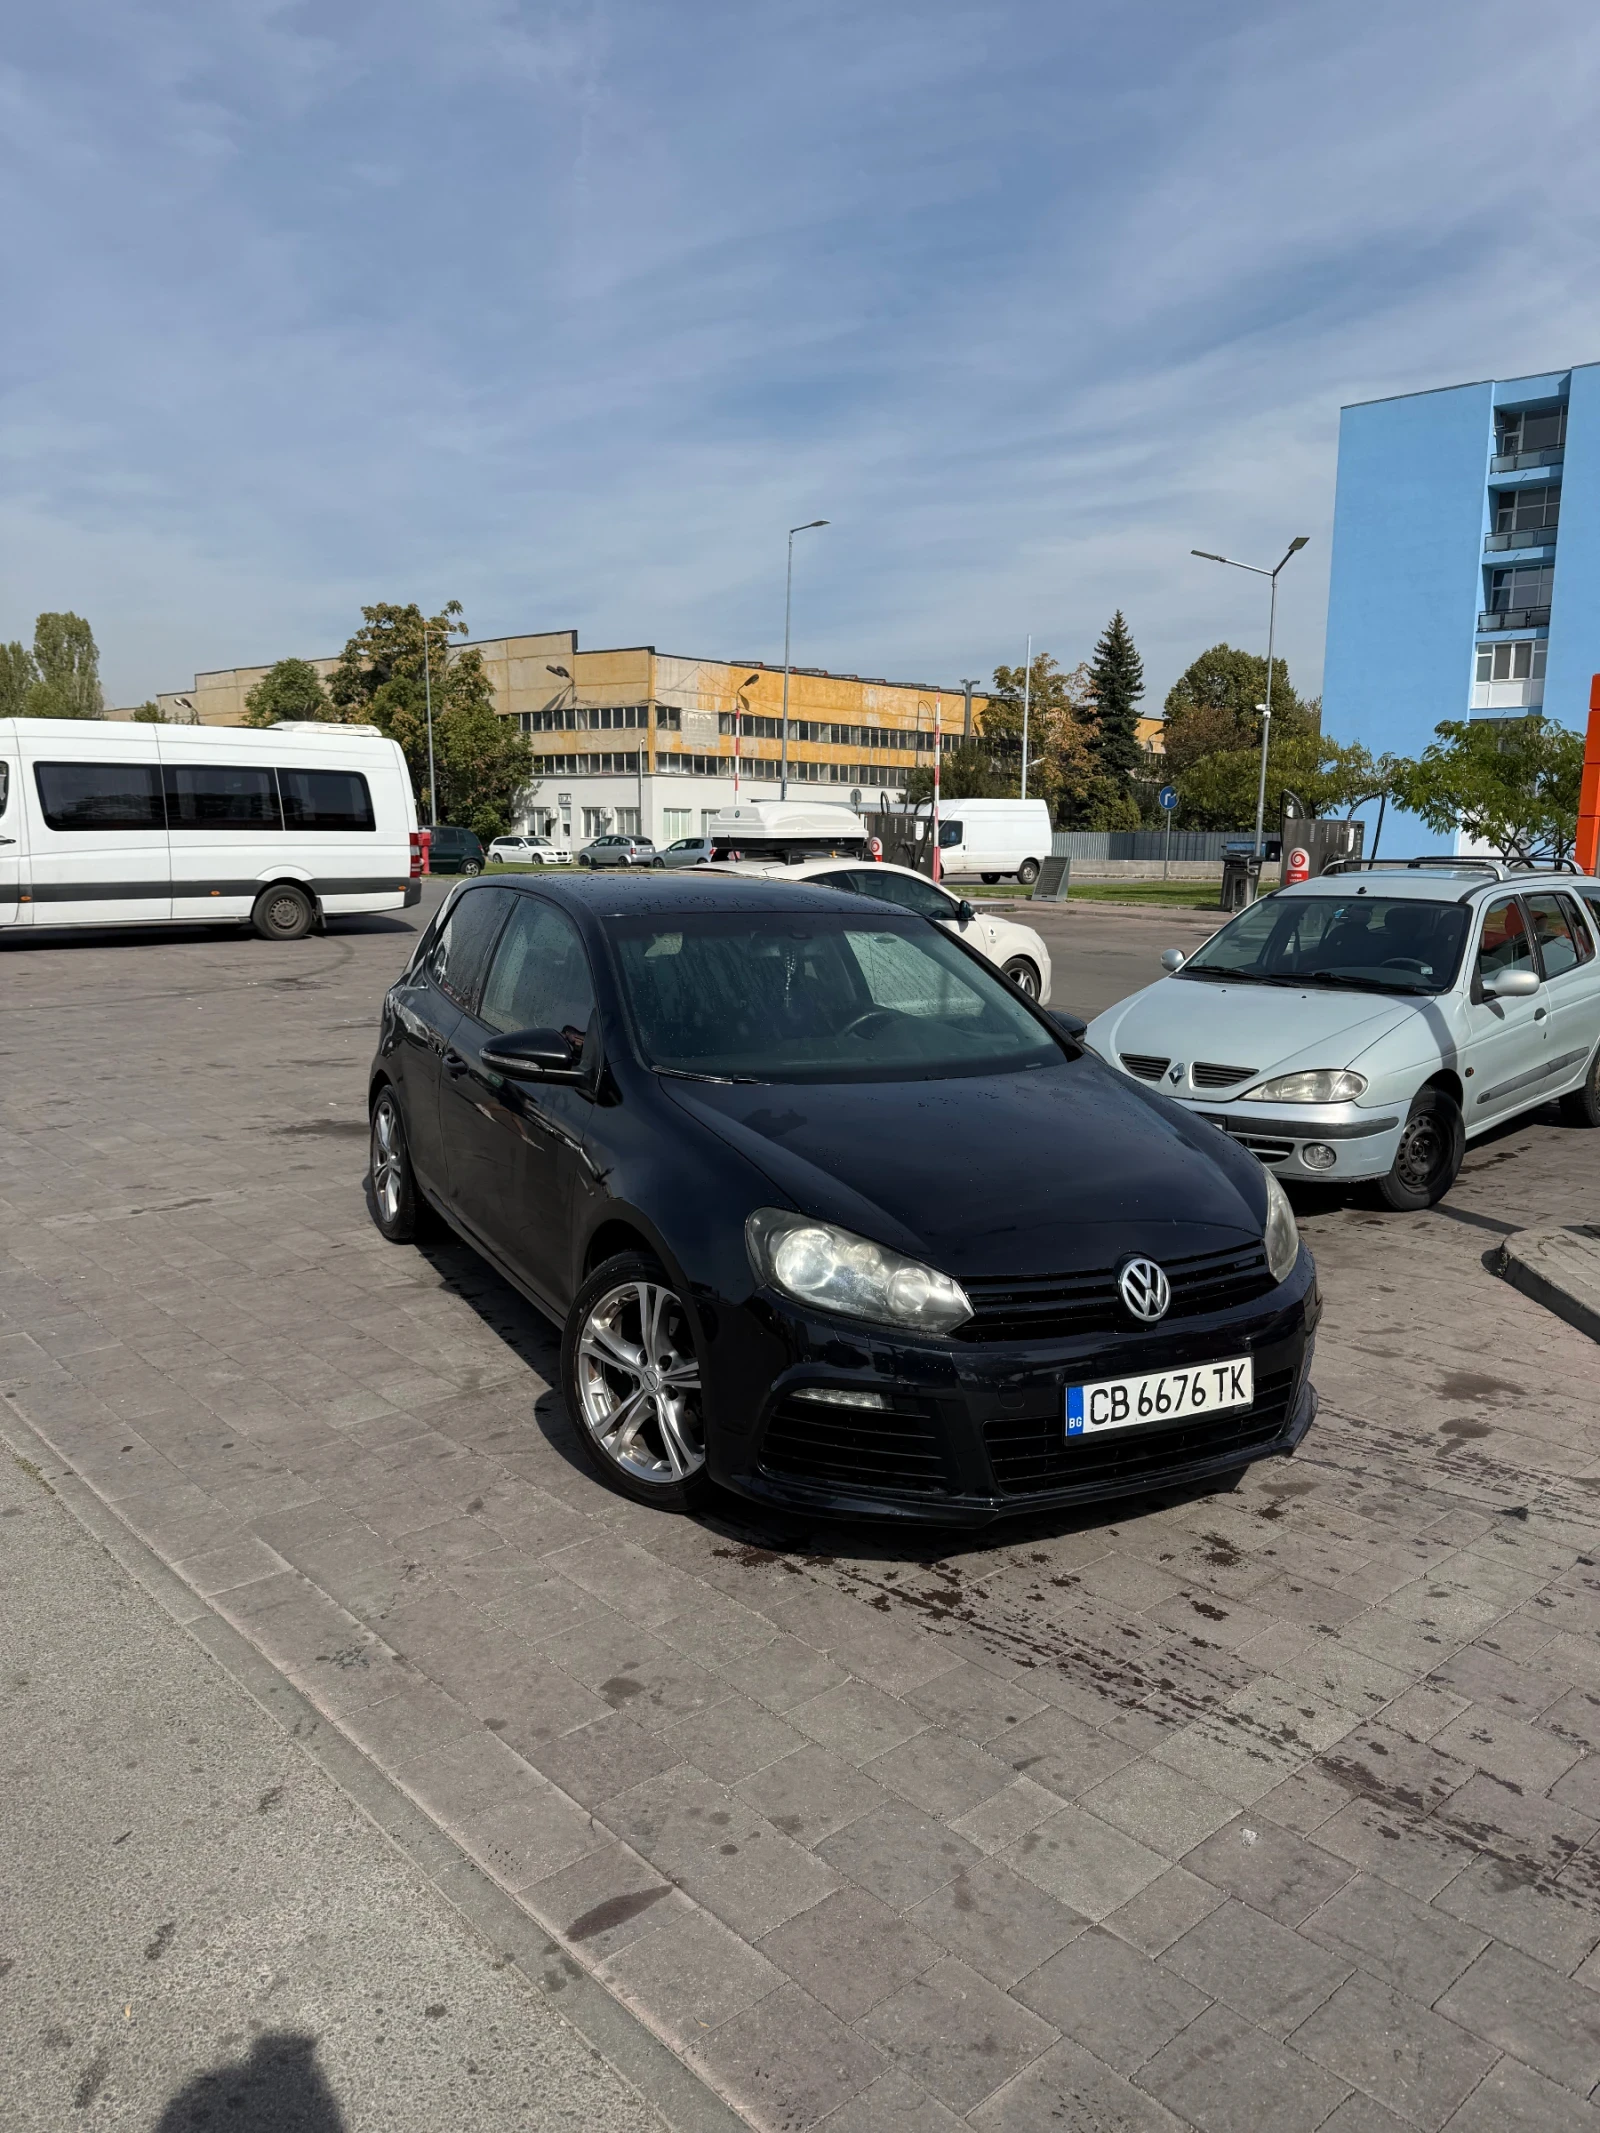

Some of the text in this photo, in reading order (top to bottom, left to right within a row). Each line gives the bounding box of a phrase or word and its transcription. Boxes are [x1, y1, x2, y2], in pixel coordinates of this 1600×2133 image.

[1089, 1363, 1246, 1425] CB 6676 TK
[1068, 1416, 1083, 1429] BG
